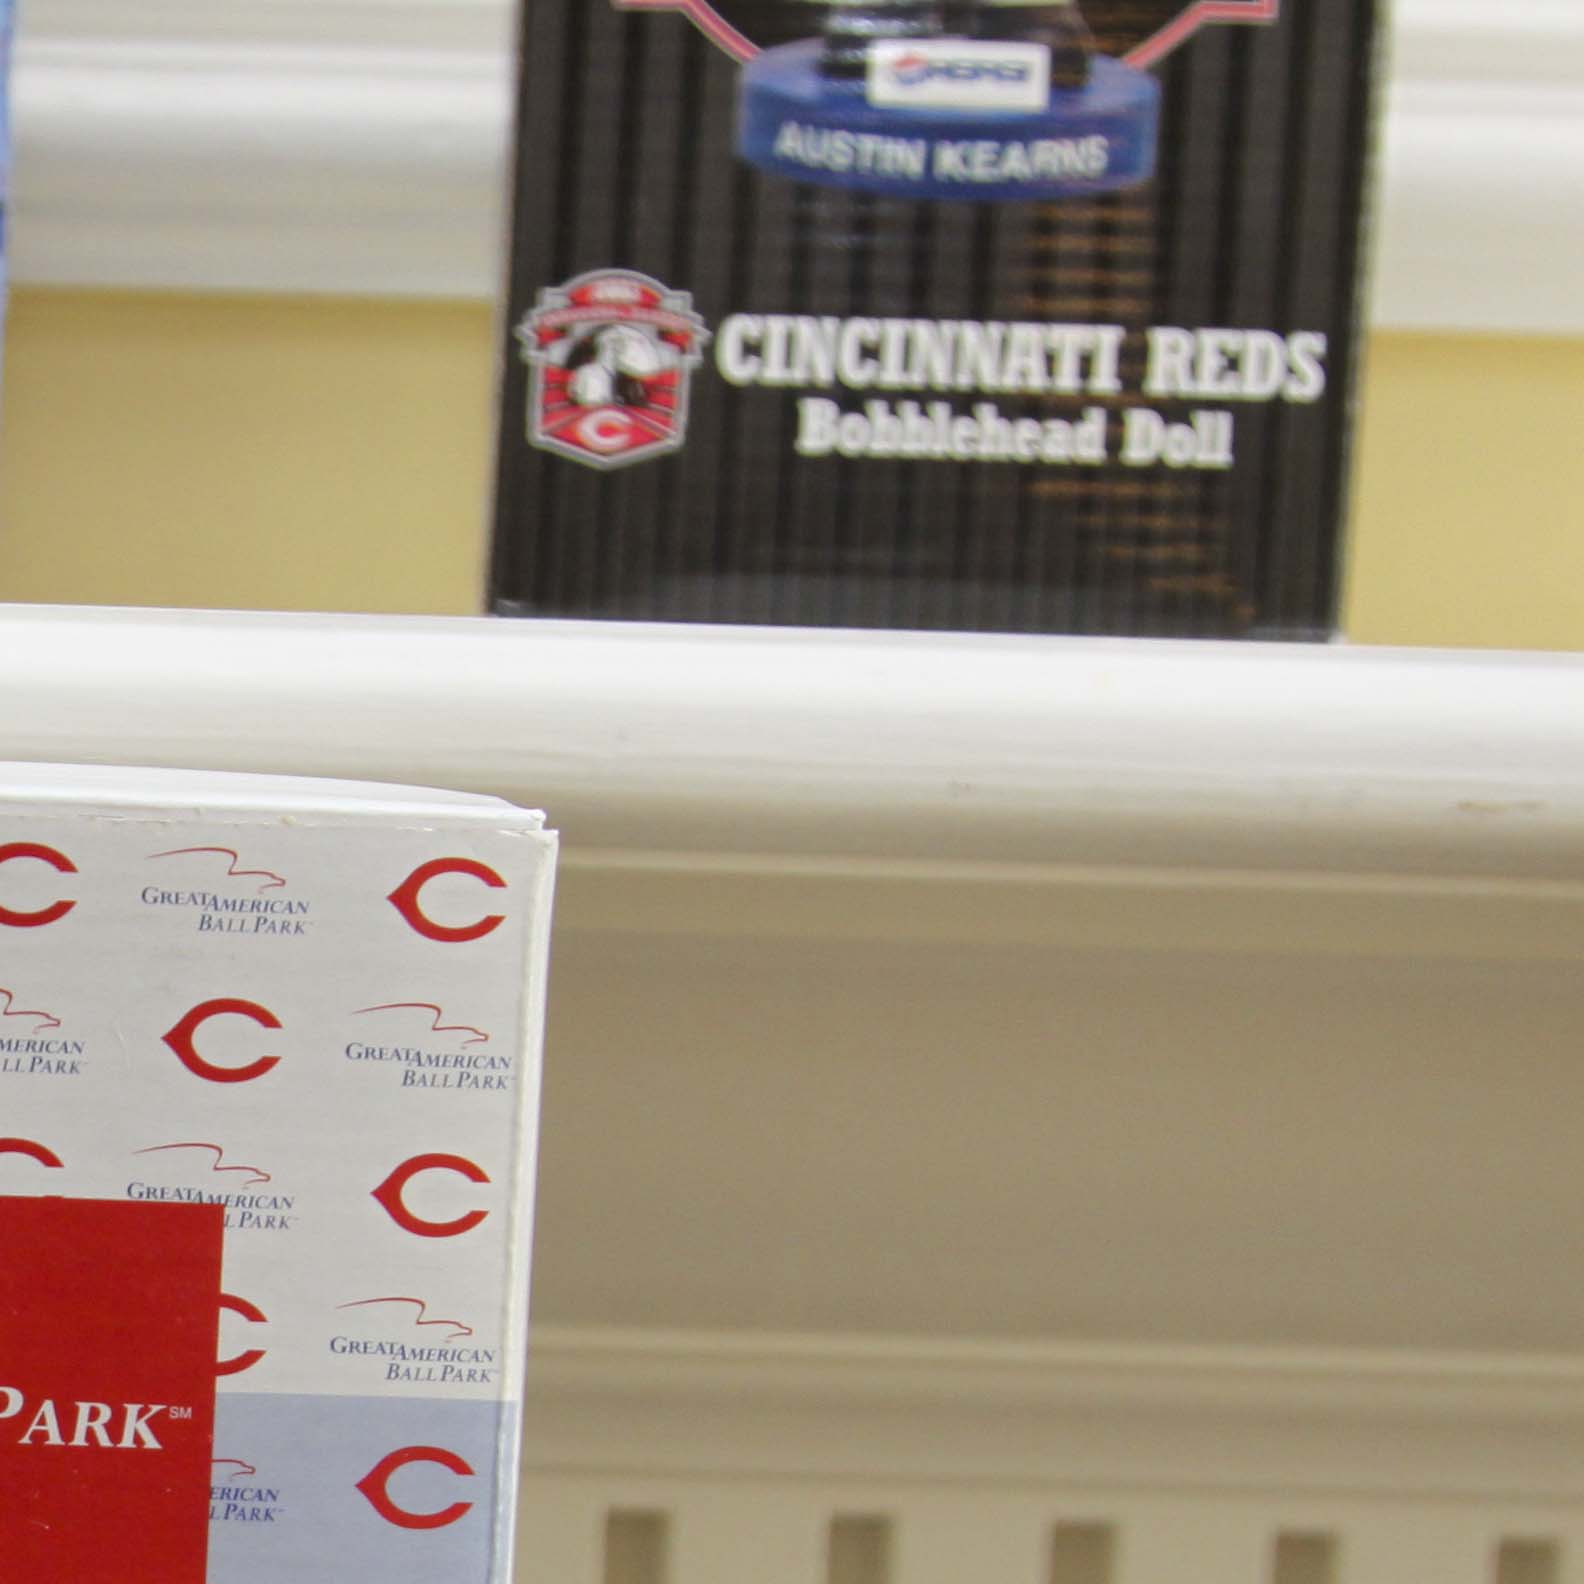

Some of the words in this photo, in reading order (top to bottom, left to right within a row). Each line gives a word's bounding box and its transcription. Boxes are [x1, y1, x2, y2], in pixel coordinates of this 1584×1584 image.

[773, 120, 928, 178] AUSTIN
[933, 133, 1109, 183] KEARNS
[715, 313, 1123, 396] CINCINNATI
[1143, 328, 1327, 402] REDS
[795, 397, 1107, 464] Bobblehead
[1122, 408, 1234, 468] Doll
[197, 914, 247, 933] BALL
[253, 916, 305, 935] PARK
[28, 1056, 80, 1075] PARK
[401, 1069, 451, 1088] BALL
[456, 1071, 507, 1090] PARK
[237, 1211, 289, 1230] PARK
[385, 1363, 436, 1382] BALL
[439, 1365, 491, 1383] PARK
[223, 1503, 275, 1522] PARK
